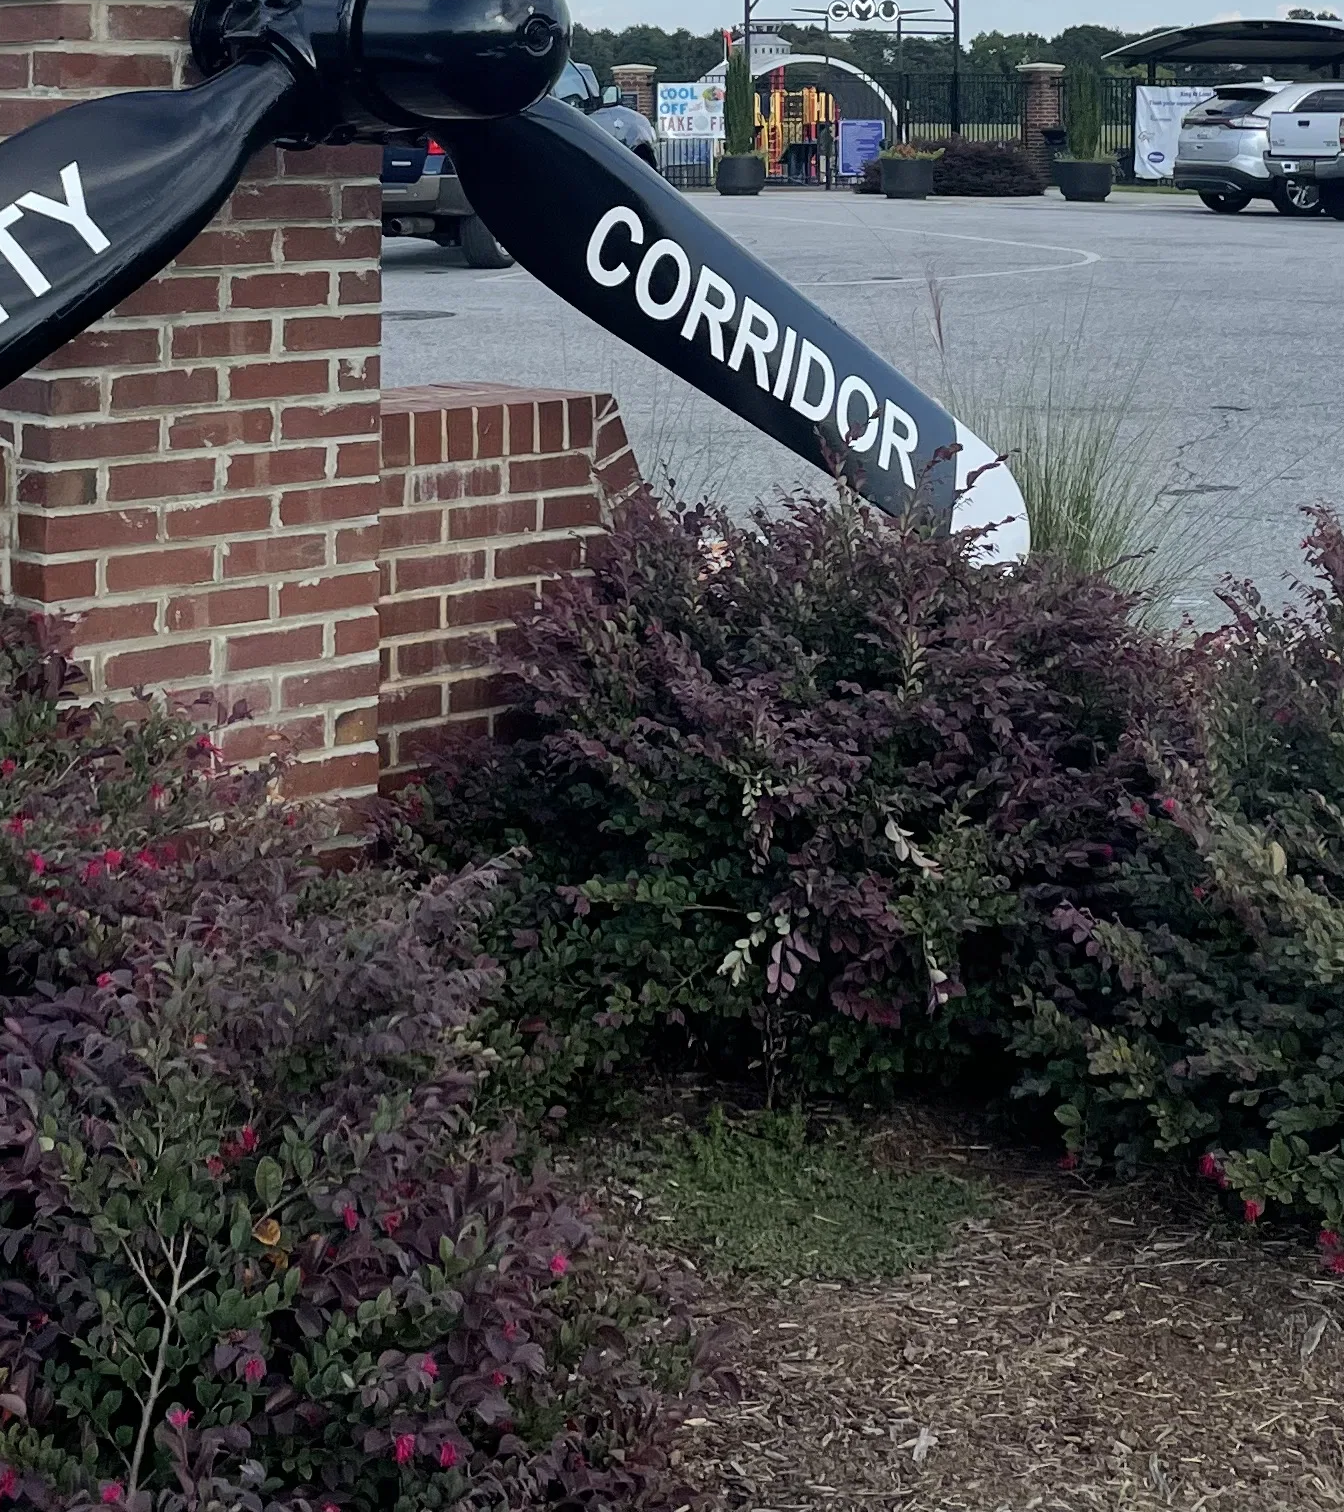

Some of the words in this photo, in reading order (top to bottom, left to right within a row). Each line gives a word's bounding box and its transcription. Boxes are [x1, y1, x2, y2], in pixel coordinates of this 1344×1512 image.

[660, 87, 698, 100] COOL
[660, 103, 688, 115] OFF
[660, 116, 693, 131] TAKE
[586, 206, 919, 489] CORRIDOR
